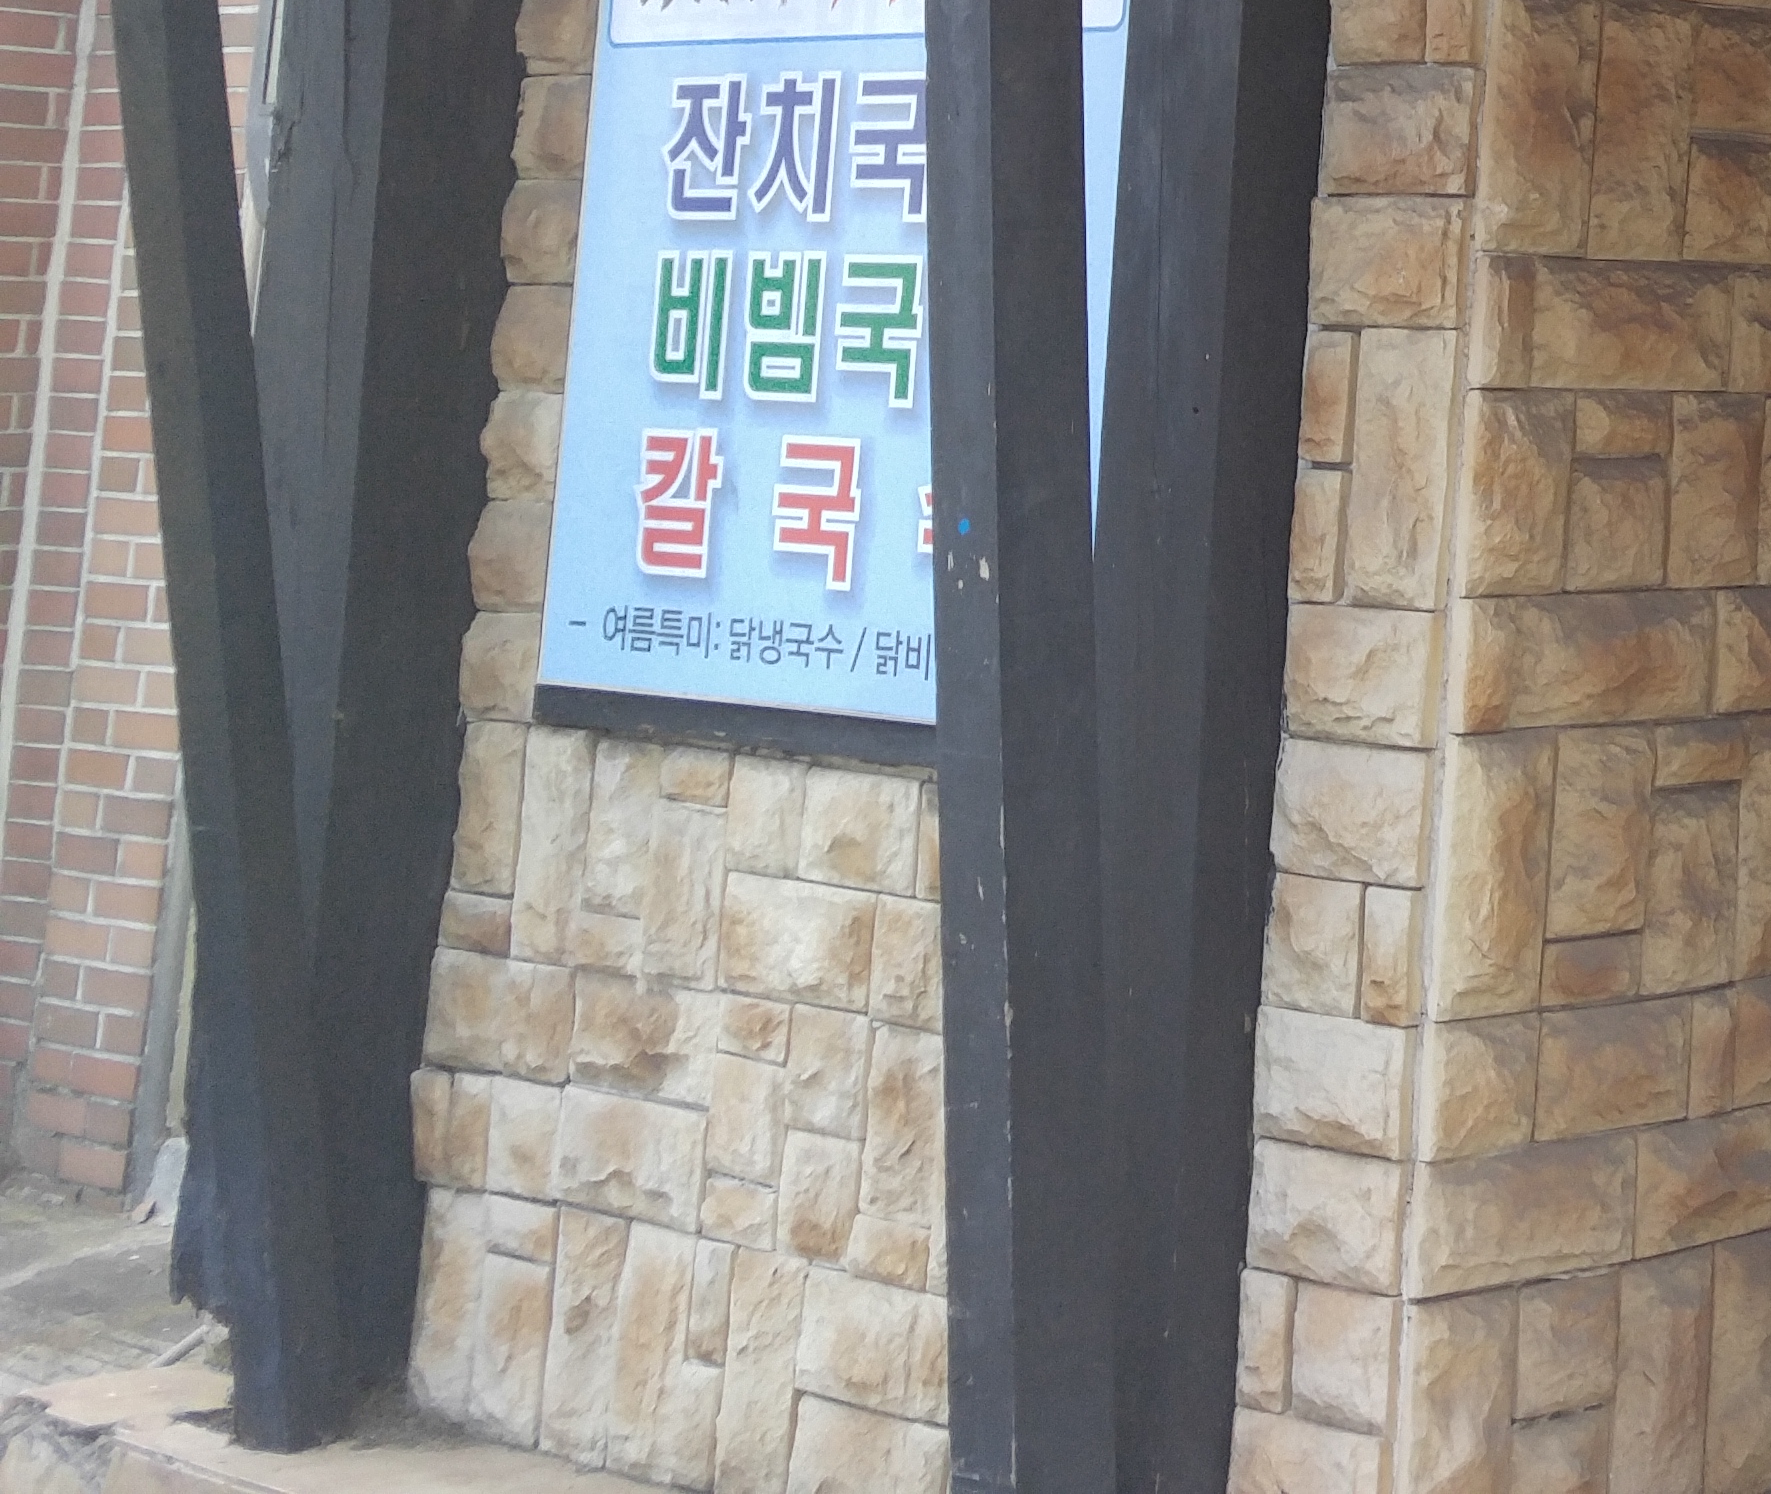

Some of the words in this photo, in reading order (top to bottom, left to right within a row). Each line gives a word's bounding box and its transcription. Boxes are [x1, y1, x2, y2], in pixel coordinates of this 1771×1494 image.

[664, 73, 926, 220] 잔치국
[650, 250, 924, 407] 비빔국
[602, 605, 721, 659] 여름특미:
[729, 617, 844, 670] 닭냉국수
[875, 630, 931, 681] 닭비
